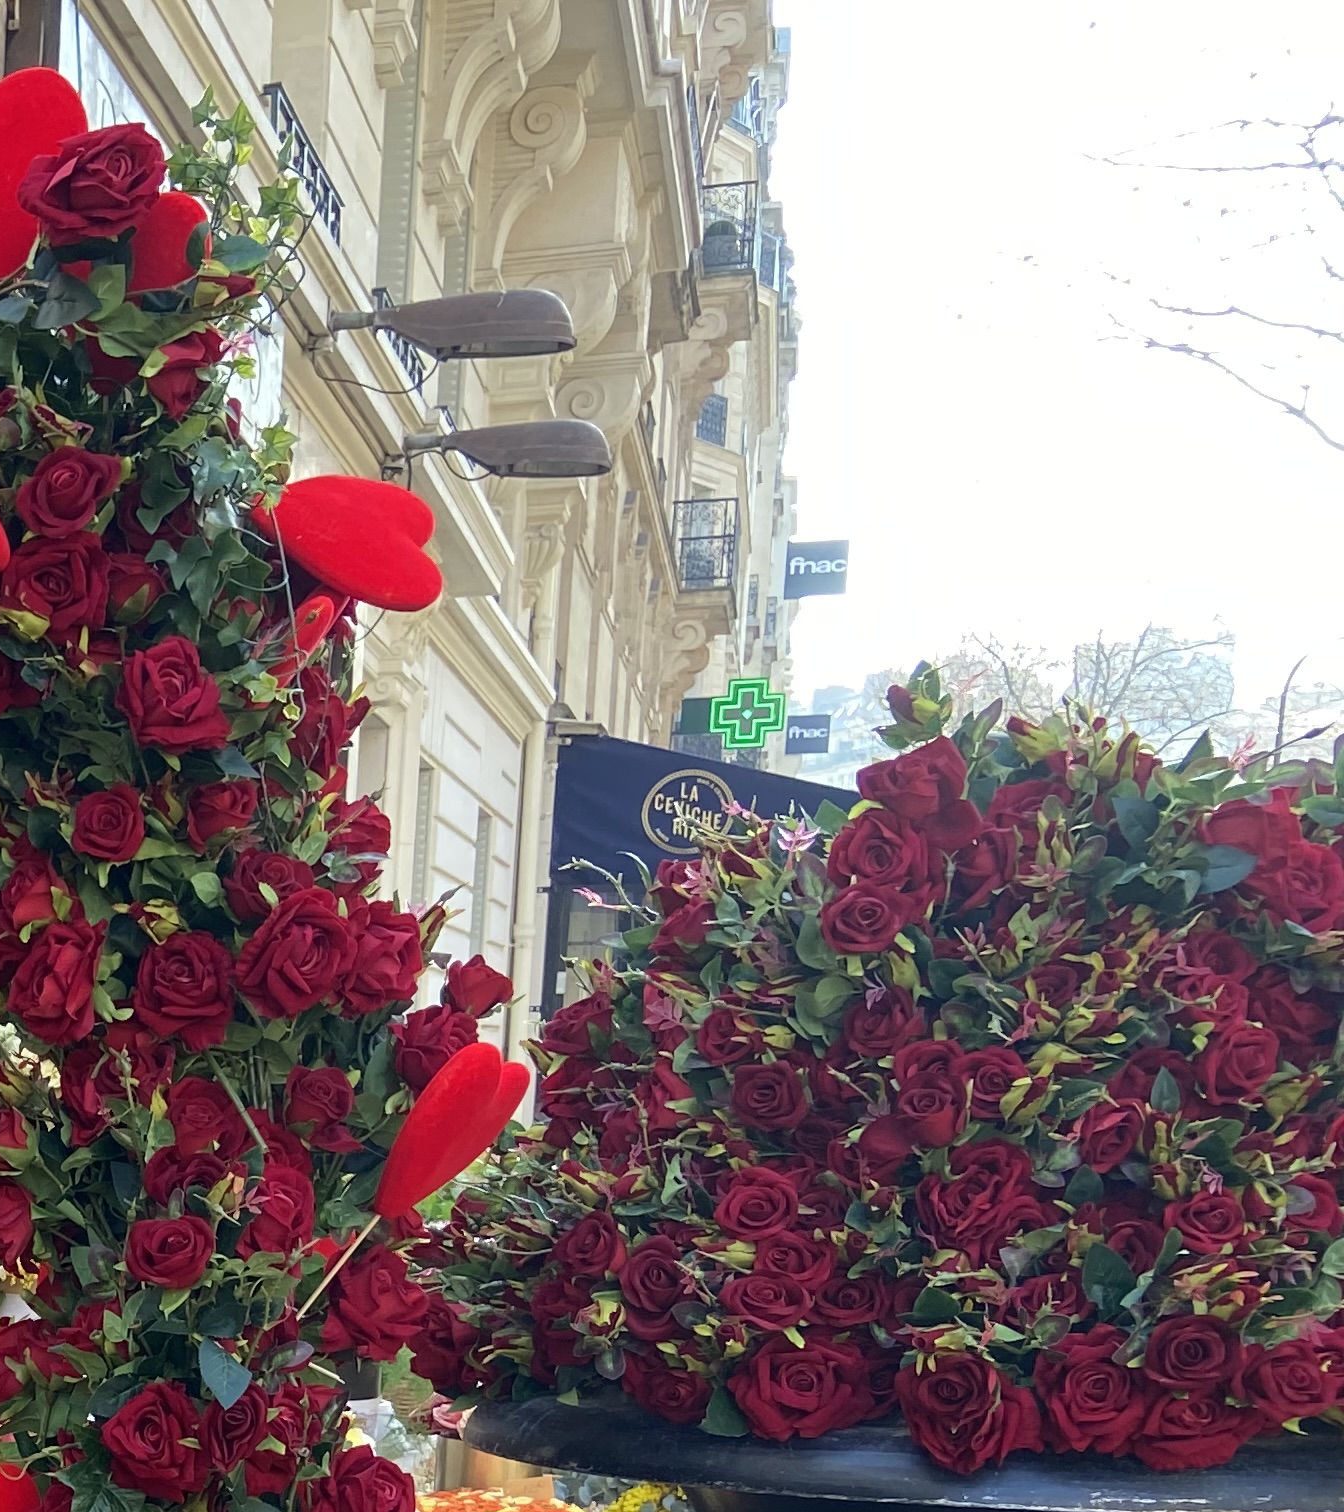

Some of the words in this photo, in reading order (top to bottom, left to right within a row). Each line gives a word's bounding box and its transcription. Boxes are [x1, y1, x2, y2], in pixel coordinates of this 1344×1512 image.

[789, 556, 848, 575] fnac
[788, 725, 829, 740] fnac
[680, 781, 700, 803] LA
